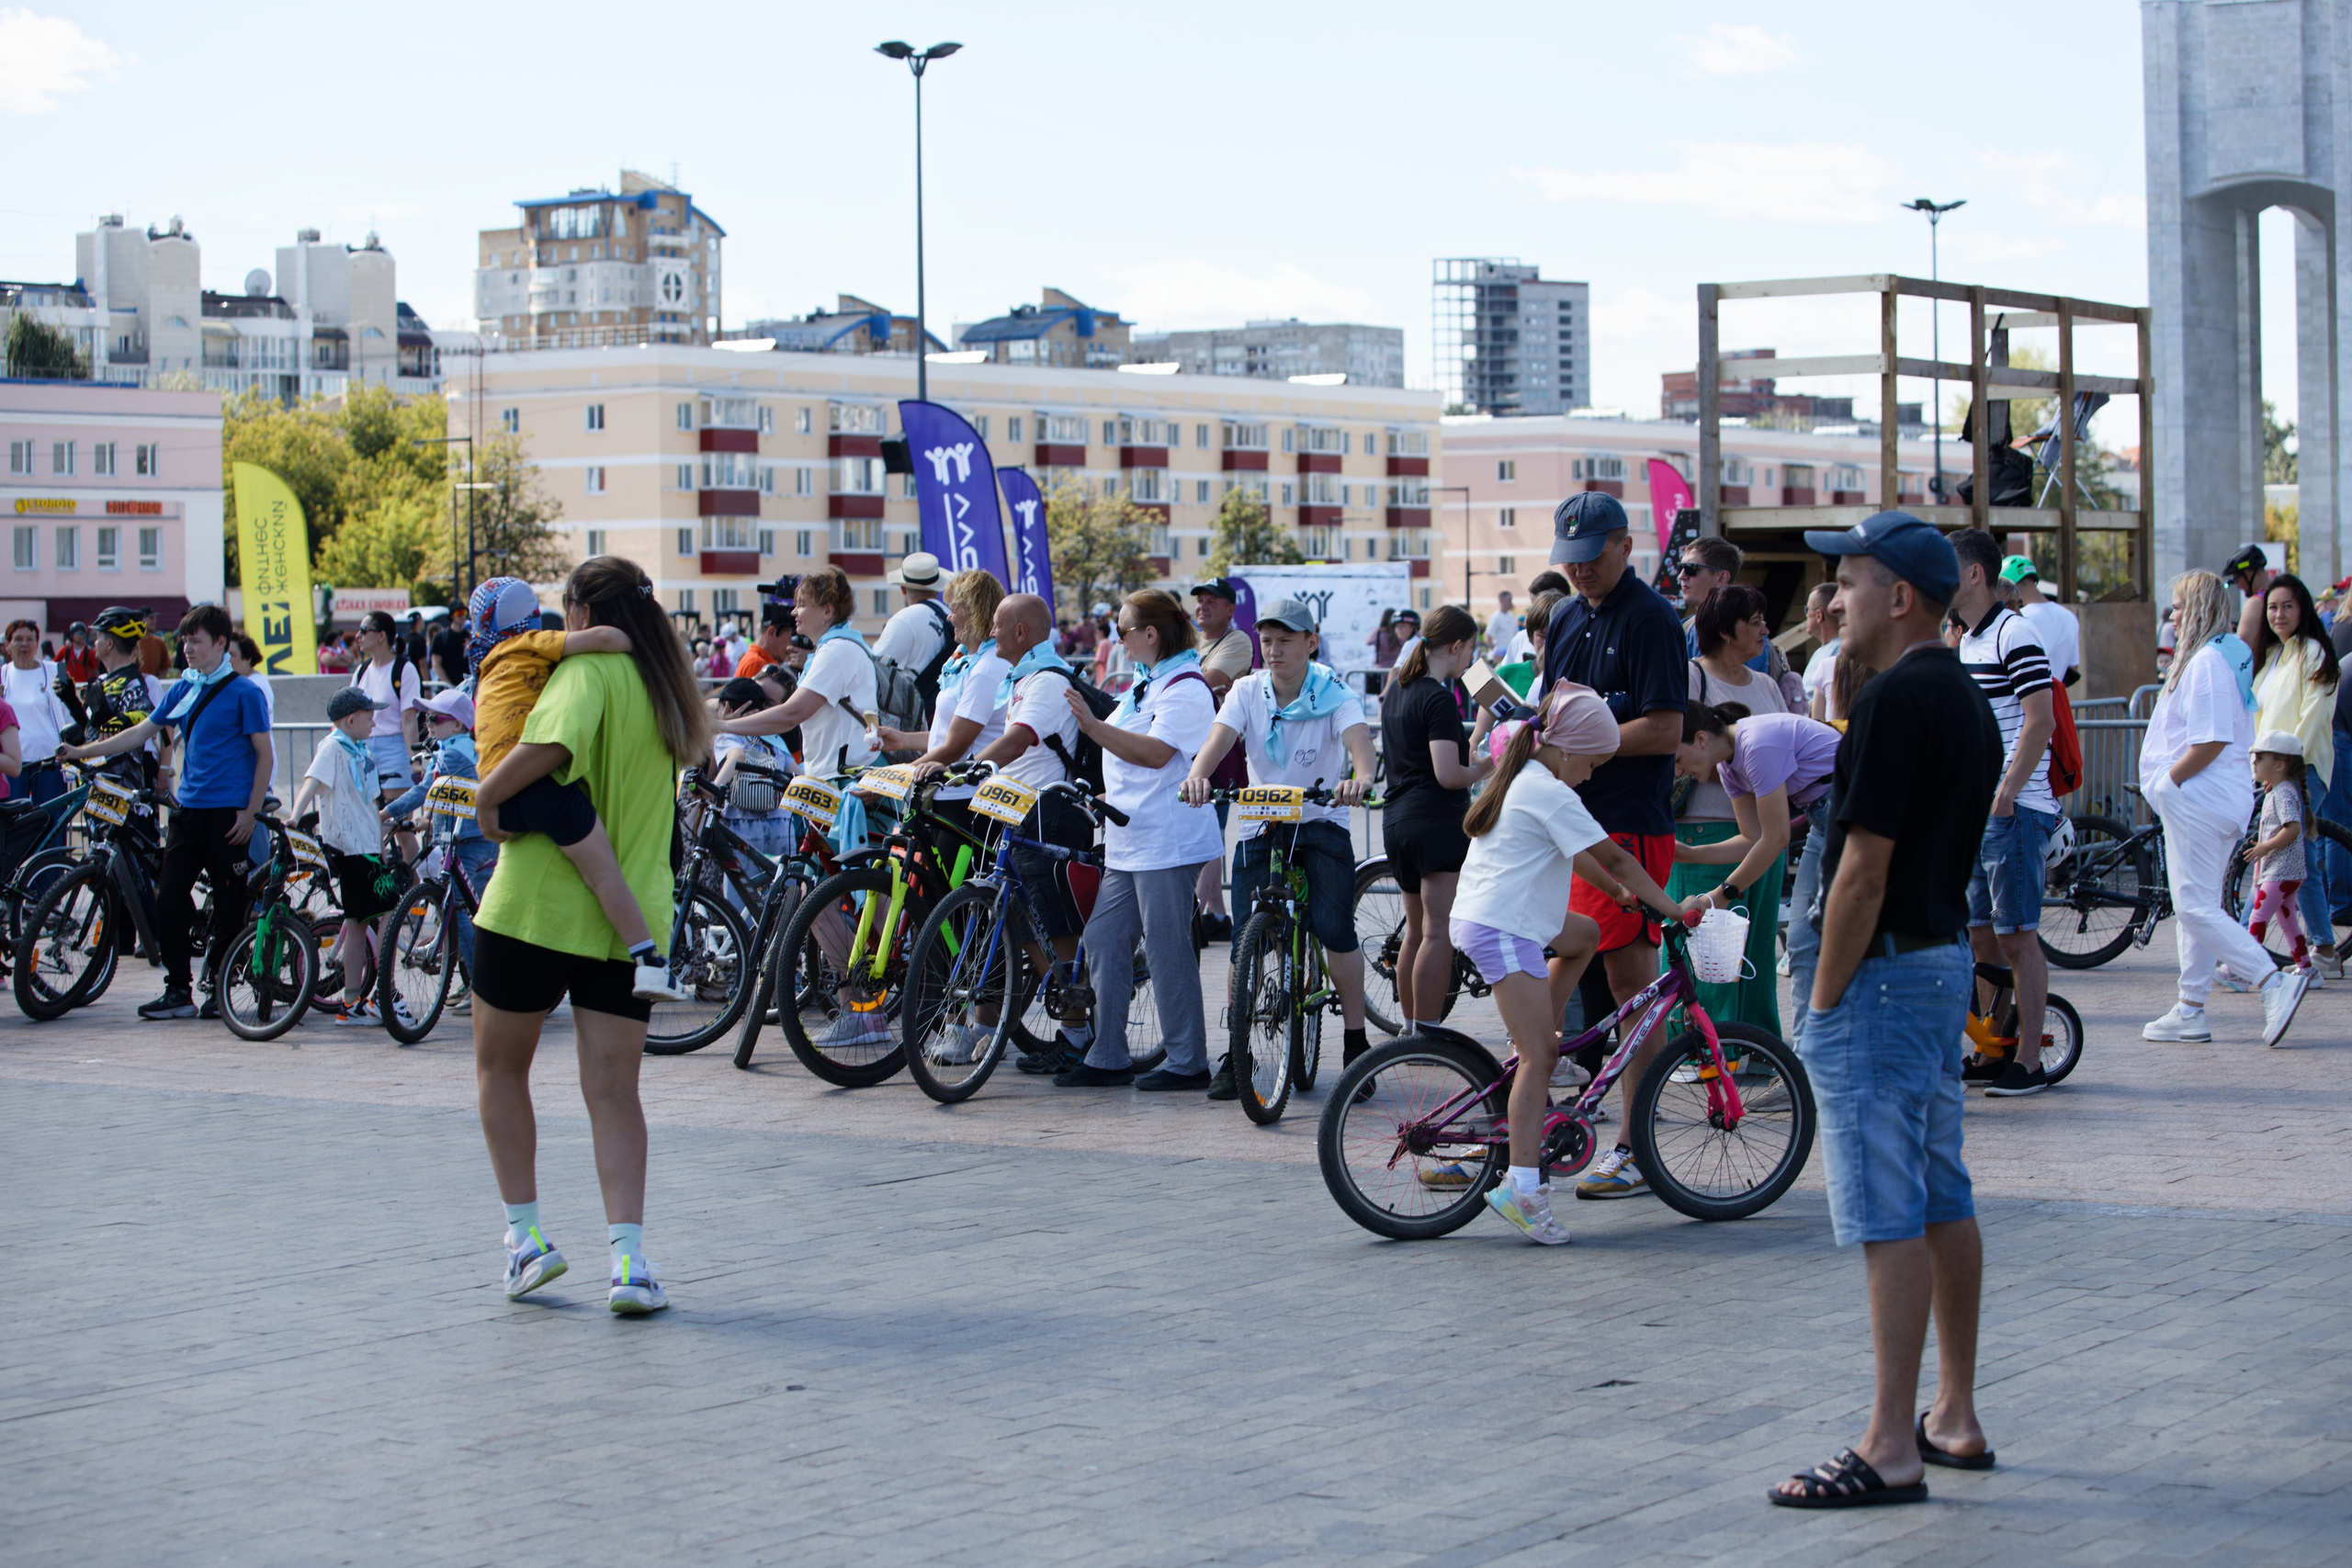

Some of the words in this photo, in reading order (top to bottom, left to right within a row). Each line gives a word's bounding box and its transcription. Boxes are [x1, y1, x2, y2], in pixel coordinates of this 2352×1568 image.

[868, 768, 908, 784] 0864
[429, 786, 469, 804] 0564
[786, 785, 832, 809] 0863
[979, 784, 1022, 807] 0961
[1242, 789, 1293, 803] 0962
[1629, 1010, 1657, 1056] STELS
